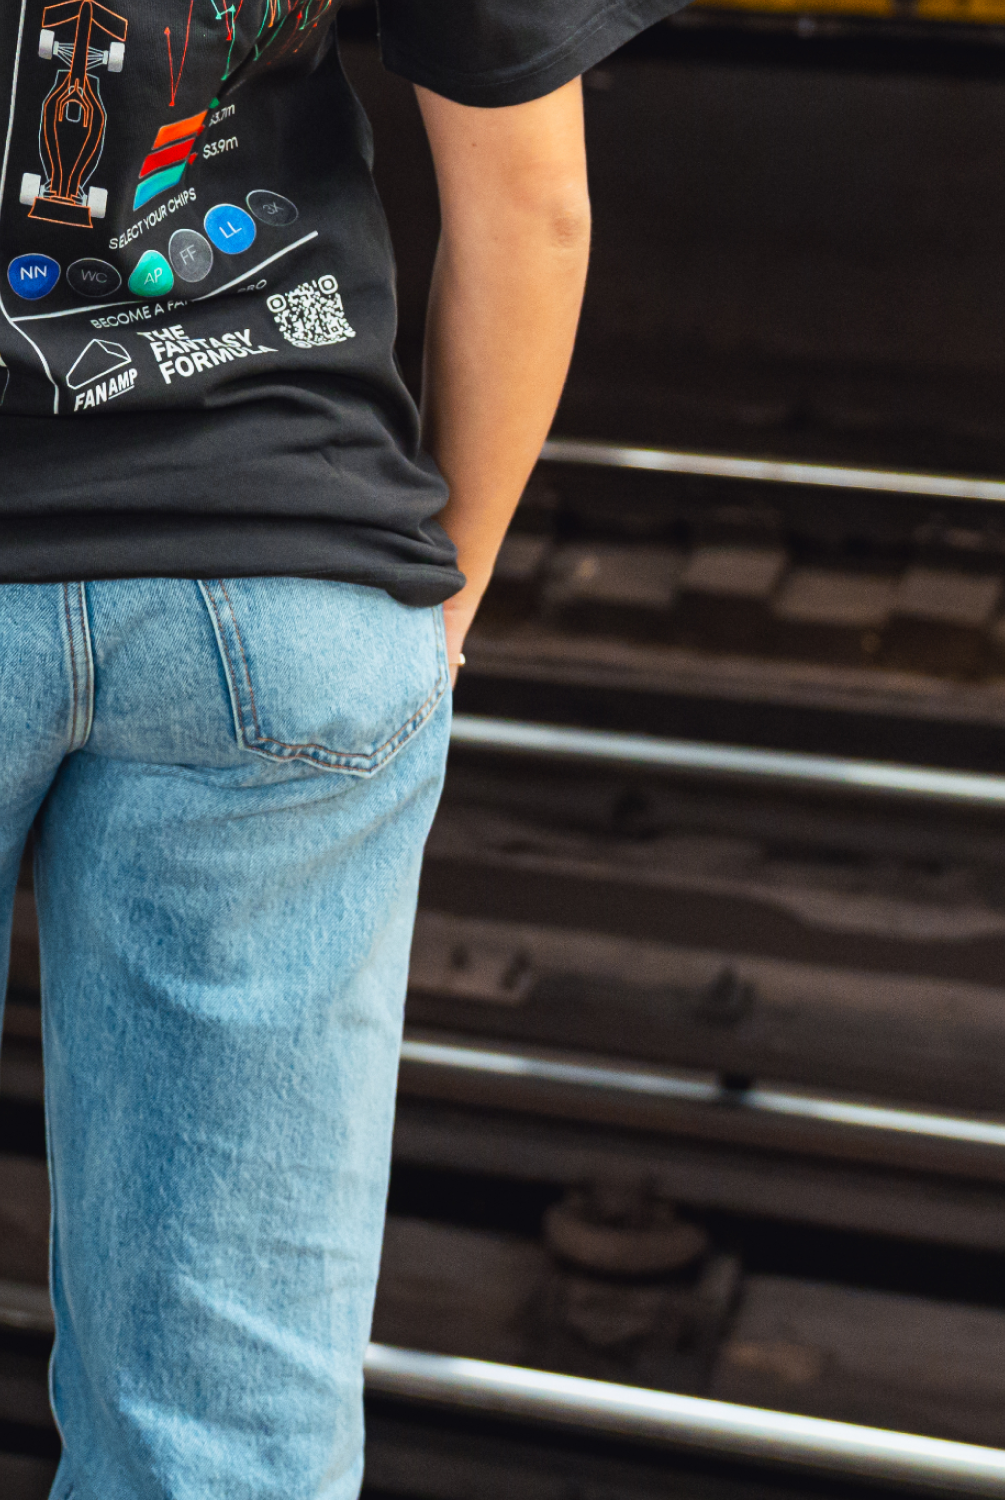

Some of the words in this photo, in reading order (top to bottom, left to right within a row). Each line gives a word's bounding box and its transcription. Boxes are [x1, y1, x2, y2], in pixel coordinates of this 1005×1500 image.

[109, 221, 143, 249] SELECT
[142, 205, 168, 230] YOUR
[168, 187, 197, 214] CHIPS
[263, 202, 284, 215] 3X
[219, 221, 242, 239] LL
[179, 244, 197, 266] FF
[20, 265, 48, 281] NN
[81, 270, 108, 283] WC
[144, 267, 163, 285] AP
[90, 306, 151, 329] BECOME
[154, 303, 165, 316] A
[136, 324, 190, 341] THE
[150, 328, 253, 362] FANTASY
[158, 344, 279, 385] FORMULA
[74, 368, 138, 412] FANAMP
